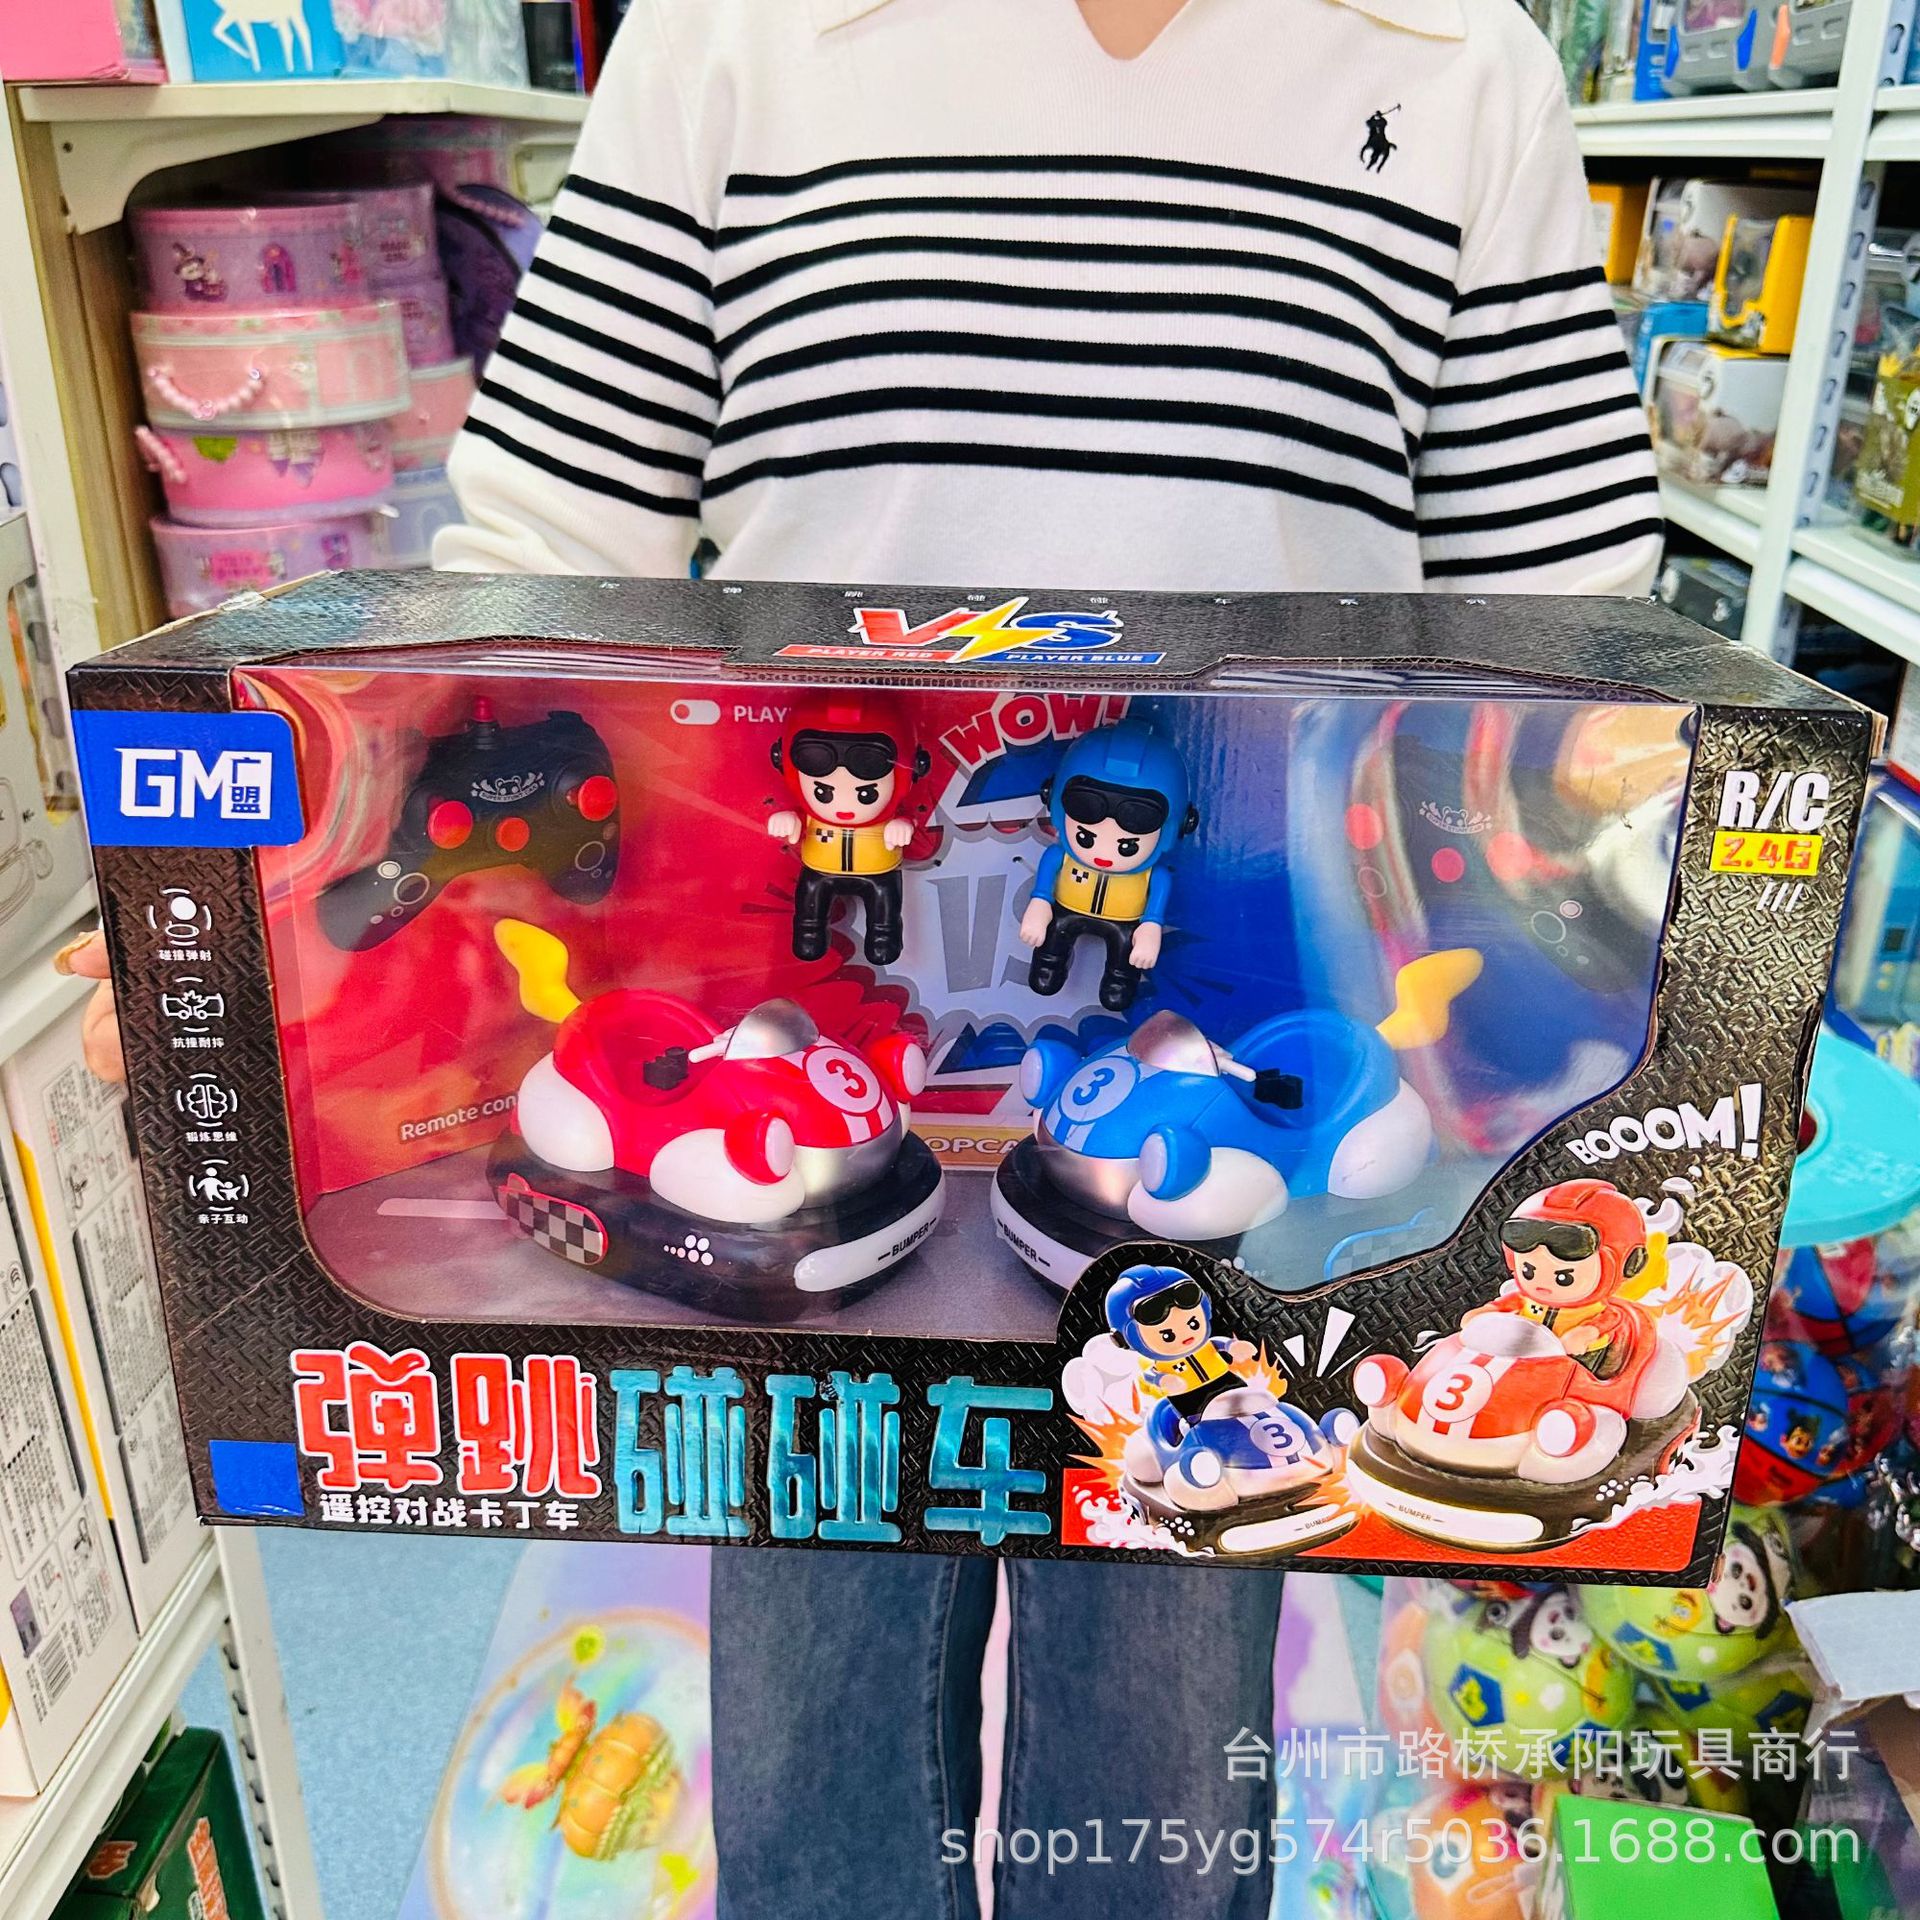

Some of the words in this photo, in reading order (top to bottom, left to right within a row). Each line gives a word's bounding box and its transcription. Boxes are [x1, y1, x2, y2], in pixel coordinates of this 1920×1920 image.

[807, 648, 885, 658] PLAYER
[891, 651, 935, 659] RED
[1005, 654, 1084, 662] PLAYER
[733, 705, 792, 723] PLAY
[939, 693, 1131, 774] WOW!
[1717, 770, 1830, 831] R/C
[1720, 836, 1813, 870] 2.4G
[158, 949, 212, 961] 碰撞弹射
[172, 1037, 225, 1049] 抗撞耐摔
[825, 1058, 868, 1099] 3
[1072, 1067, 1116, 1107] 3
[400, 1107, 479, 1141] Remote
[1565, 1083, 1762, 1165] BOOOM!
[198, 1213, 249, 1225] 亲子互动
[891, 1222, 930, 1257] BUMPER
[1003, 1226, 1038, 1263] BUMPER
[1434, 1373, 1473, 1411] 3
[1262, 1423, 1293, 1449] 3
[318, 1494, 580, 1532] 遥控对战卡丁车
[1398, 1504, 1432, 1521] BUMPER
